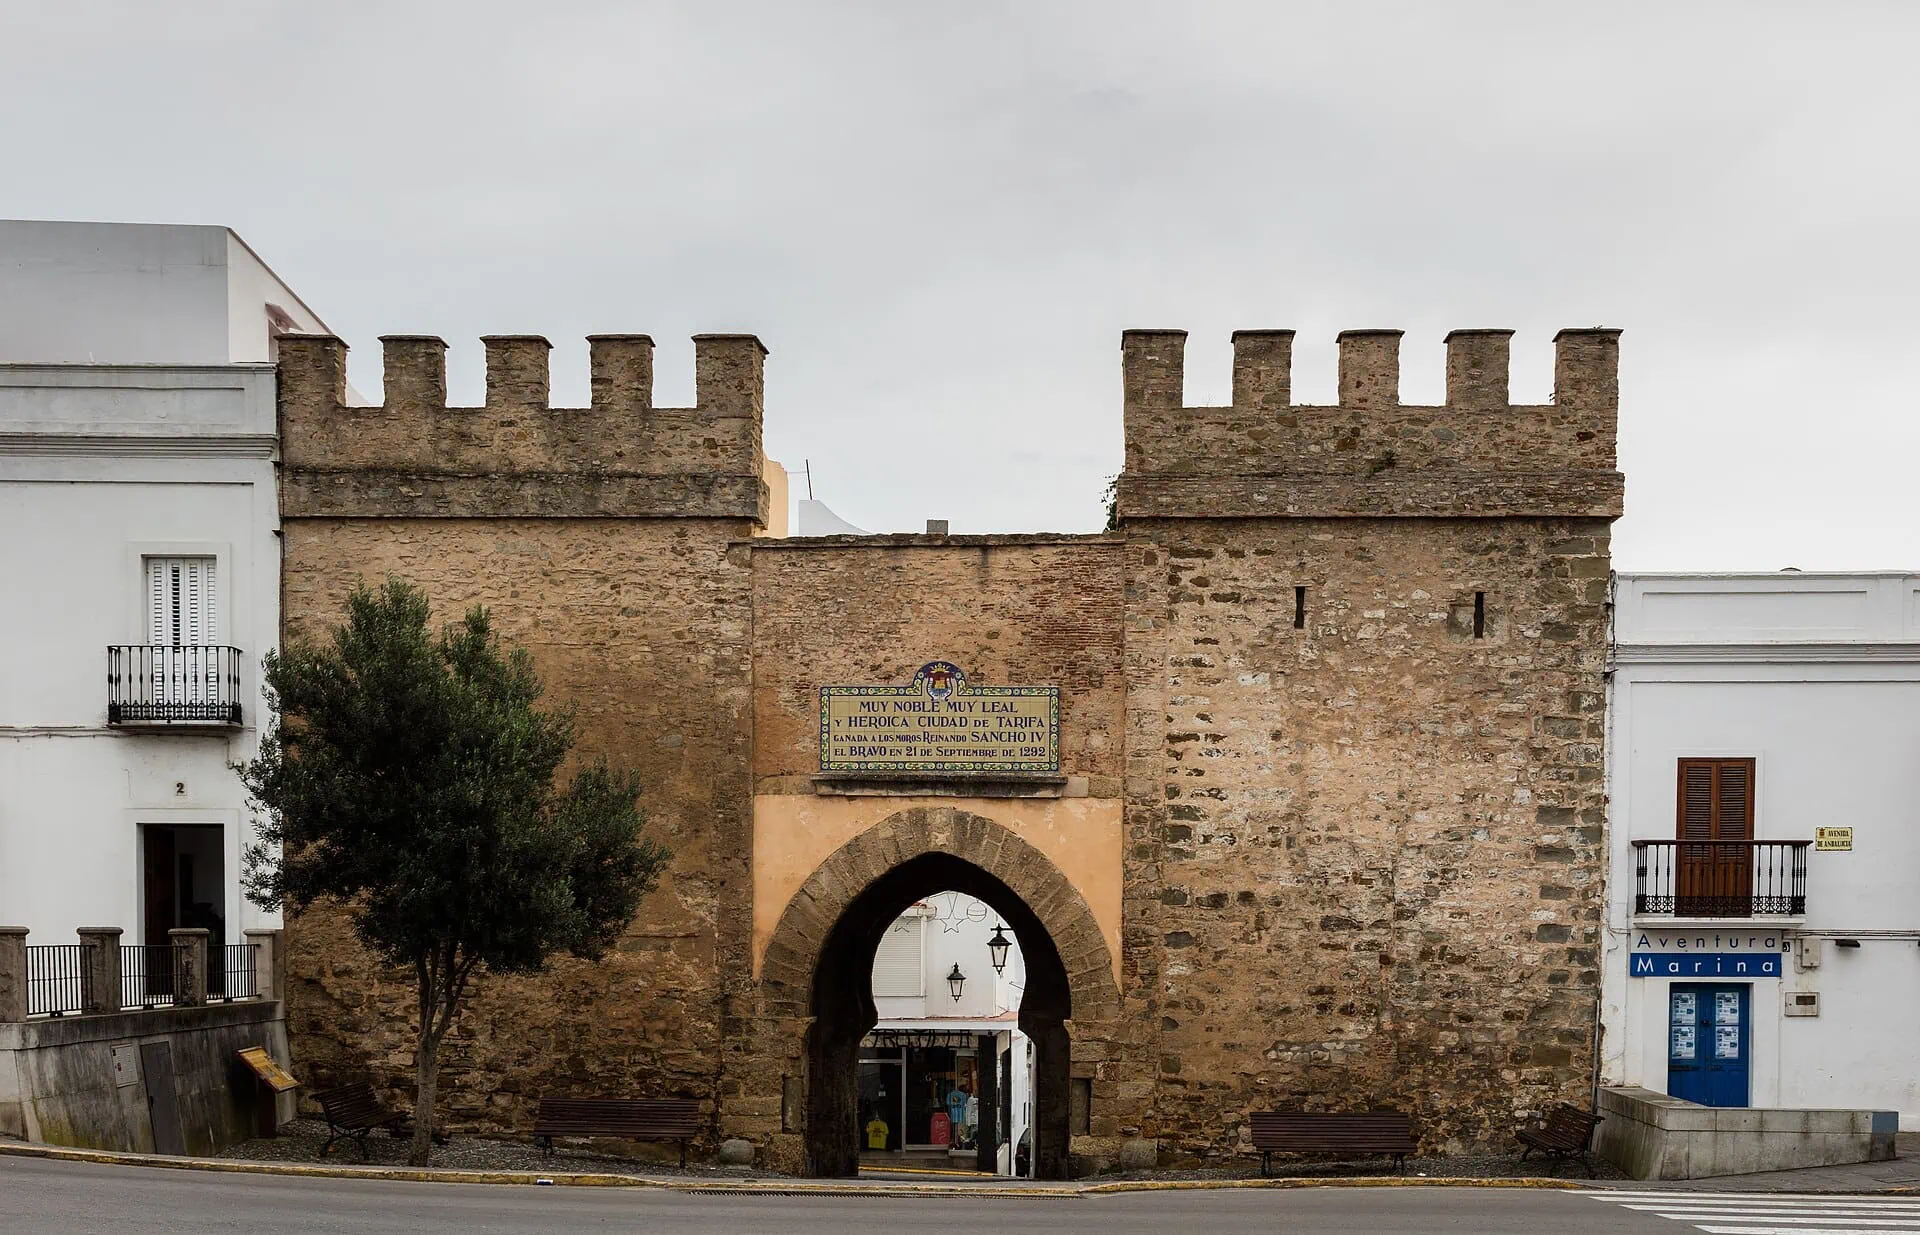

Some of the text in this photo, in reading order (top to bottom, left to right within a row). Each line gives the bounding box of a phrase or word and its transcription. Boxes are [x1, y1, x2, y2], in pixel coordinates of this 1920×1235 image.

[859, 700, 1019, 713] MUY NOBLE MUY LEAL
[835, 716, 1045, 729] Y HEROICA CIUDAD DE TARIFA
[833, 734, 867, 742] GANADA
[871, 734, 877, 742] A
[878, 734, 894, 742] LOS
[895, 734, 922, 743] MOROS
[971, 731, 1026, 743] SANCHO
[1031, 731, 1045, 743] IV
[834, 748, 847, 756] EL
[849, 745, 887, 757] BRAVO
[889, 748, 902, 756] EN
[905, 746, 917, 756] 21
[920, 748, 933, 756] DE
[1002, 749, 1015, 757] DE
[1019, 746, 1046, 757] 1292
[176, 782, 185, 794] 2
[1636, 933, 1776, 949] Aventura
[1636, 957, 1774, 973] Marina
